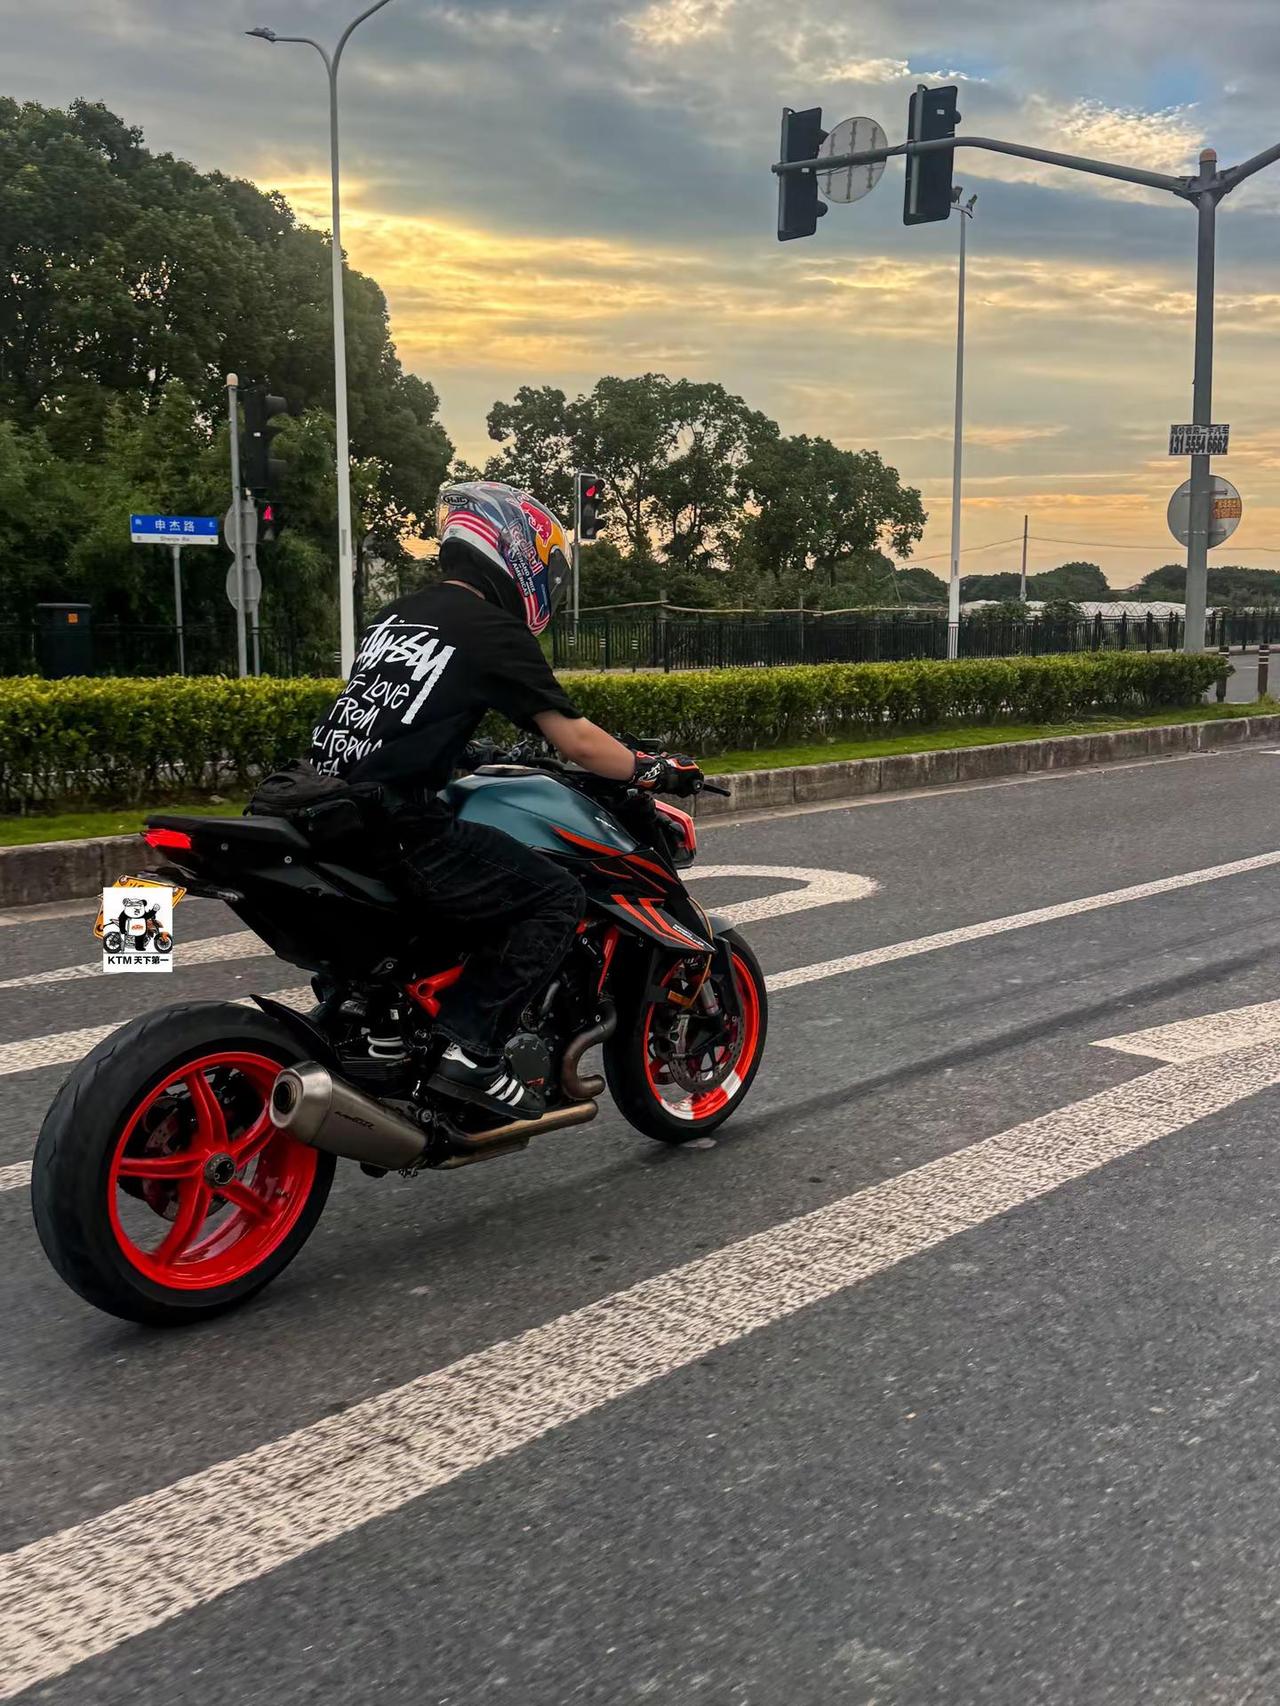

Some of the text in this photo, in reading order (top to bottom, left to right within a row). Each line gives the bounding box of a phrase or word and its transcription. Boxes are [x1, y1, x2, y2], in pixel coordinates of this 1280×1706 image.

[155, 519, 195, 532] 申杰路
[527, 546, 544, 577] Bull
[328, 696, 380, 736] FROM
